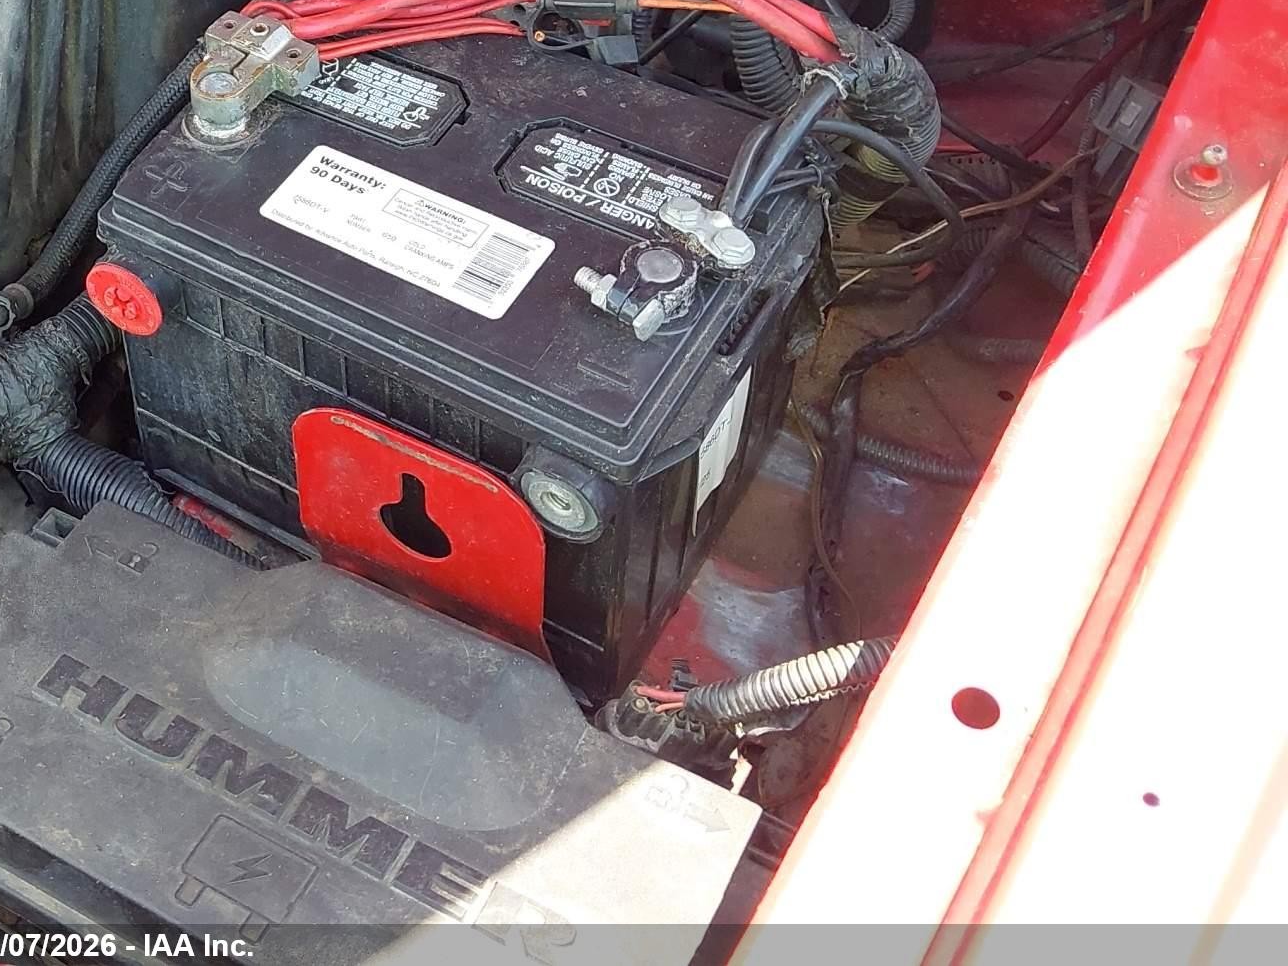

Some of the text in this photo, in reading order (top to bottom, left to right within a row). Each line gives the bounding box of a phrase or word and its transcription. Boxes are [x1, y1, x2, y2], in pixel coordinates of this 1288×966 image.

[534, 145, 555, 156] ACID
[309, 165, 367, 195] 90 Days
[319, 155, 387, 189] Warranty:
[609, 172, 625, 183] NO
[525, 174, 587, 204] POISON
[641, 194, 663, 206] EYES
[642, 187, 673, 203] LOSIVE
[600, 200, 655, 230] ANGER
[628, 197, 659, 212] SHIELD
[32, 653, 578, 966] HUMMER
